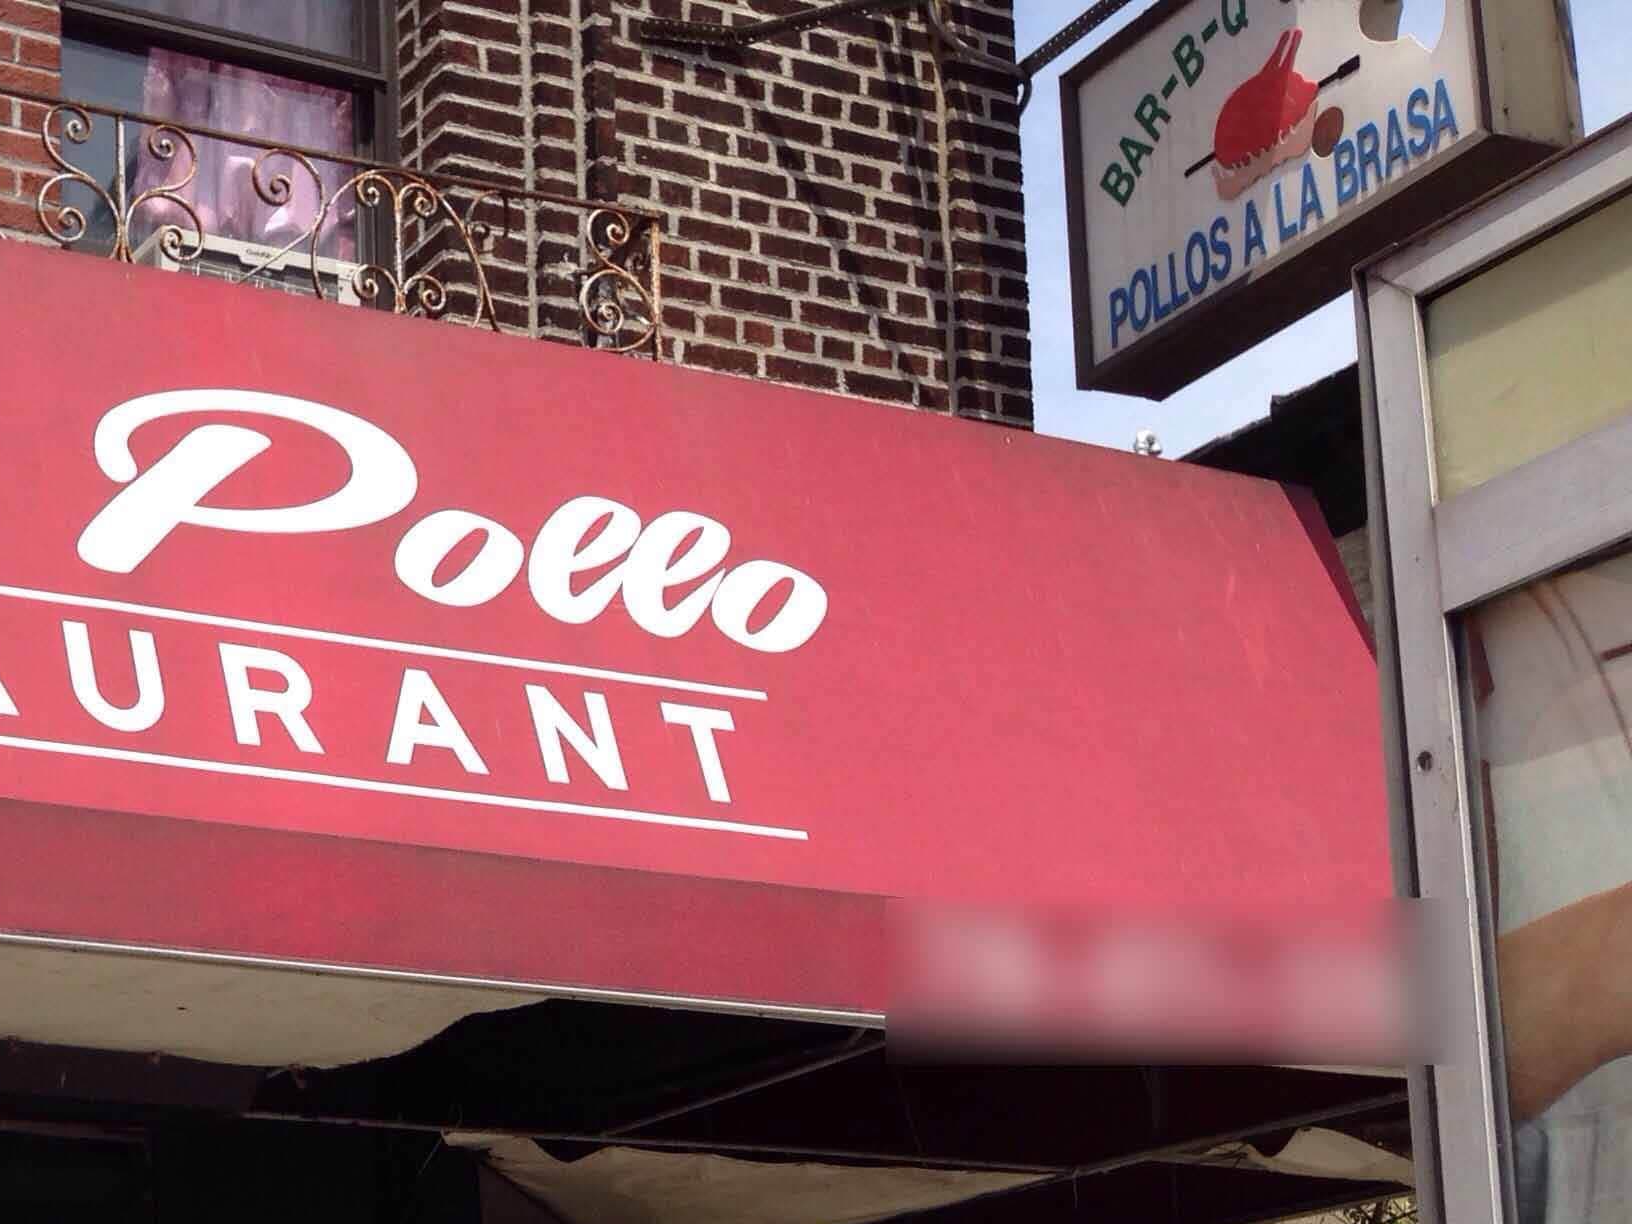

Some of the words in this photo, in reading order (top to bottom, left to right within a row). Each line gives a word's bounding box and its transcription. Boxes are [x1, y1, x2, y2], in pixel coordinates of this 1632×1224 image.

[1109, 215, 1232, 348] POLLOS
[1244, 200, 1267, 267] A
[1274, 163, 1324, 242] LA
[1332, 79, 1458, 207] BRASA
[76, 388, 829, 654] Pollo
